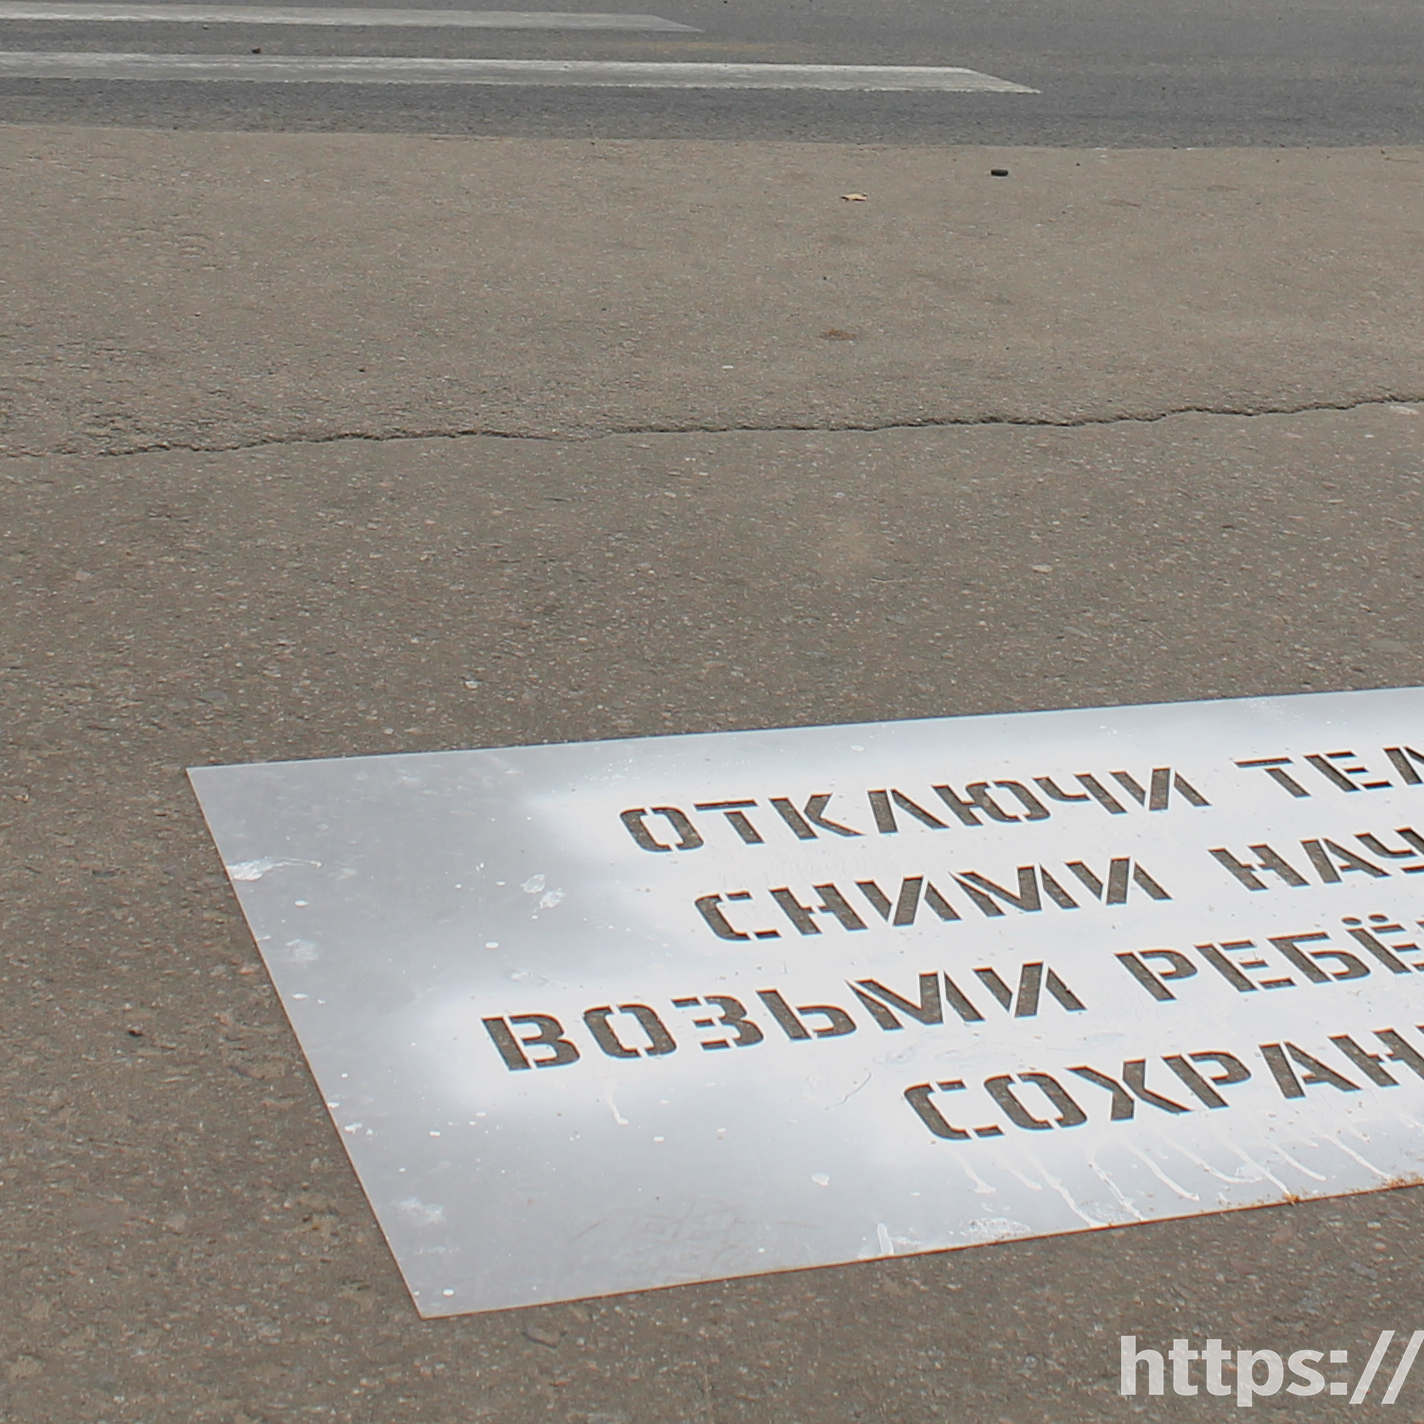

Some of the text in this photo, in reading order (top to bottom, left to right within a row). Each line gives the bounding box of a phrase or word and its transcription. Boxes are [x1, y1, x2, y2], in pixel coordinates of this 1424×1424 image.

[620, 767, 1211, 852] ОТКЛЮЧИ
[690, 858, 1172, 944] СНИМИ
[481, 962, 1086, 1072] ВОЗЬМИ
